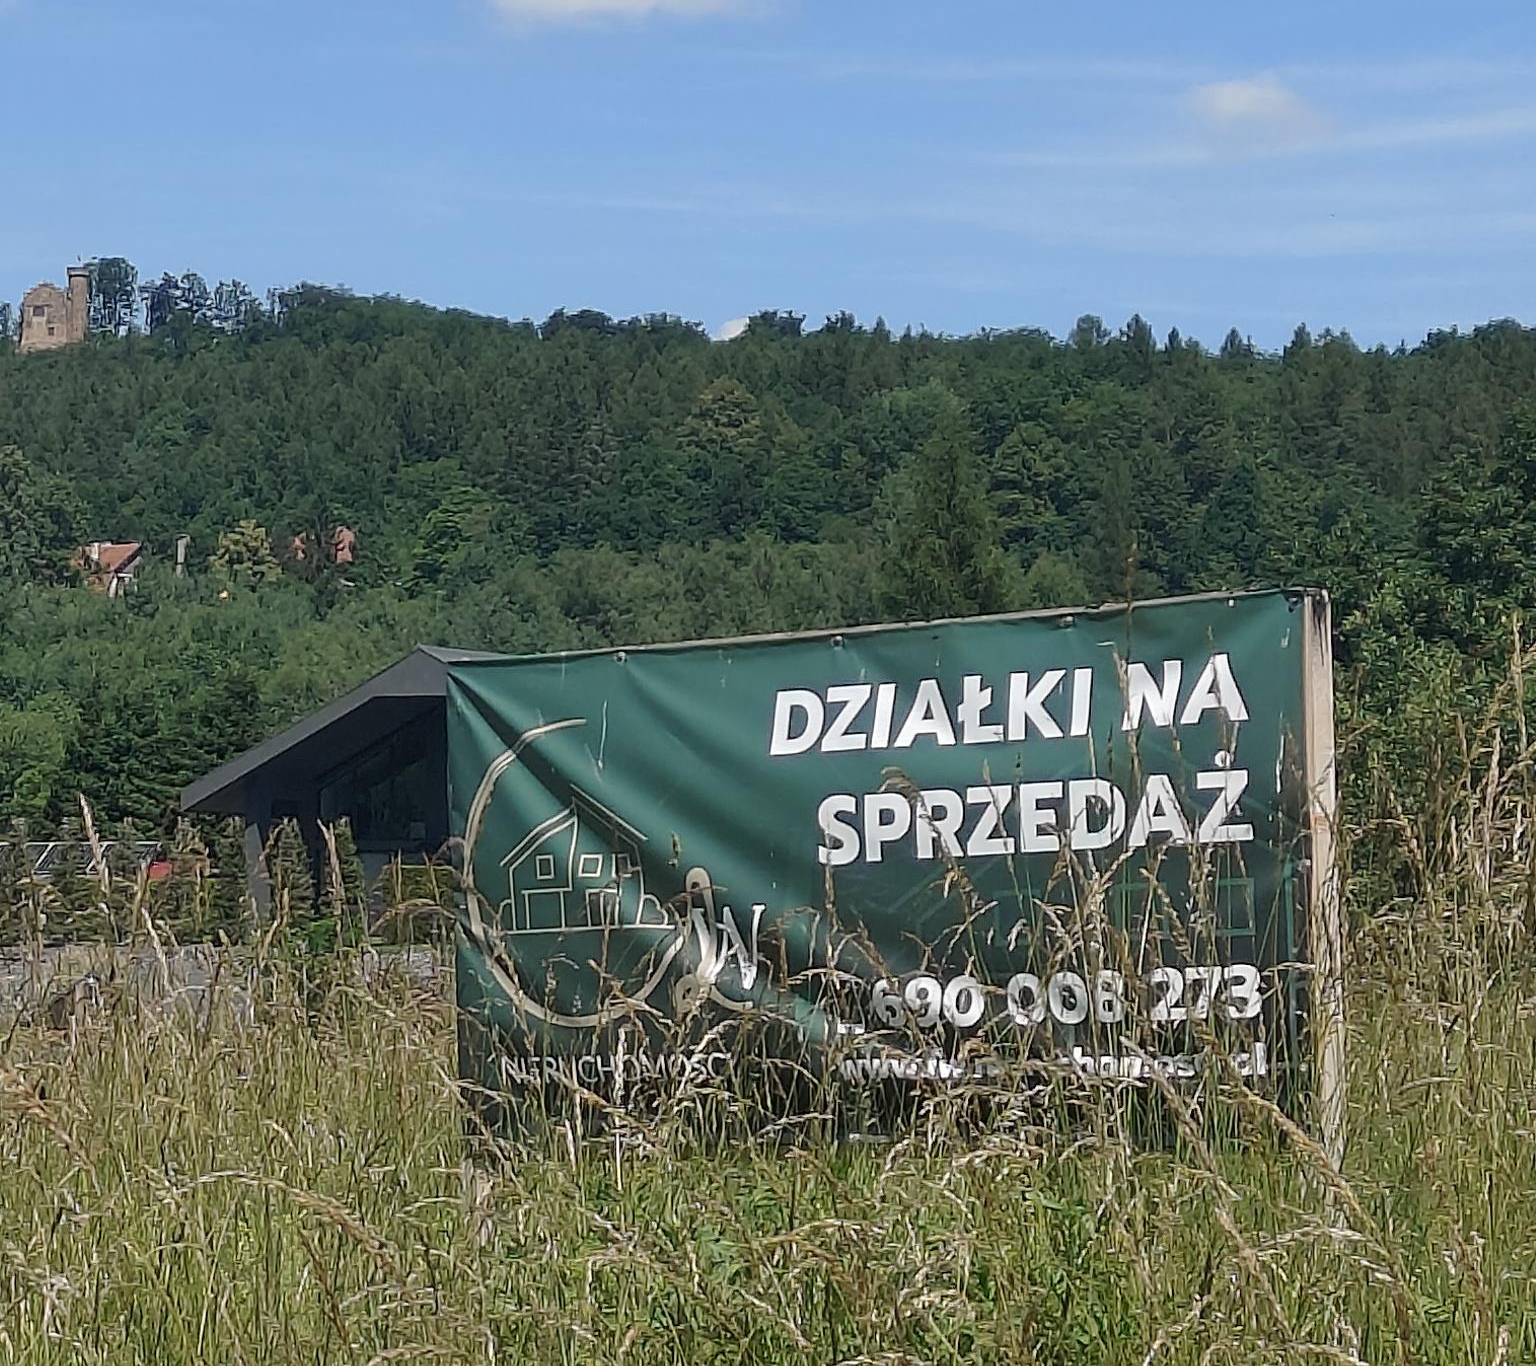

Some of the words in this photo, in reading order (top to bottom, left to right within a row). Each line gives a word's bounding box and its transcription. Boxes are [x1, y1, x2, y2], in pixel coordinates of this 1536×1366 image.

[769, 667, 1094, 756] DZIAŁKI
[1121, 653, 1250, 731] NA
[817, 750, 1255, 866] SPRZEDAŻ
[871, 973, 987, 1028] 690
[1007, 968, 1126, 1025] 008
[1150, 963, 1263, 1022] 273
